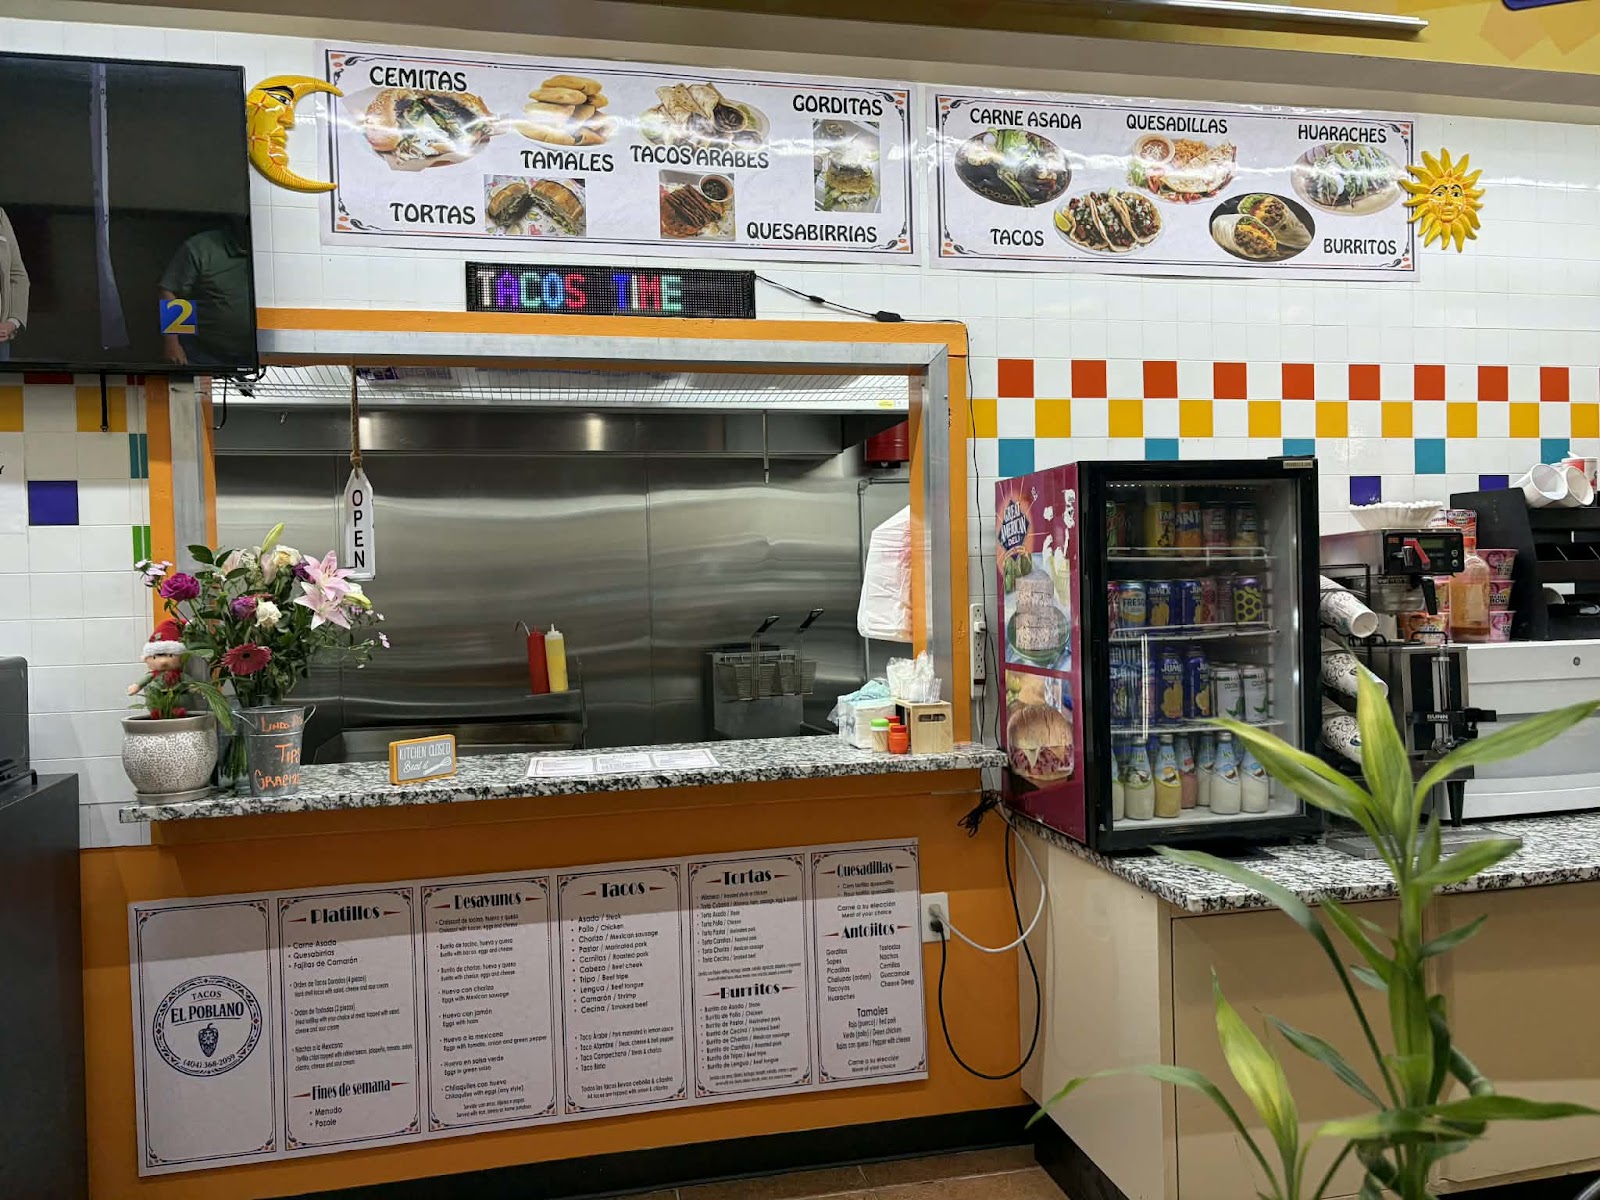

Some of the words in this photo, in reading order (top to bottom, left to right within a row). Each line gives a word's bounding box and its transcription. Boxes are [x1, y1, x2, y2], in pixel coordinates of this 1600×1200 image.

[369, 66, 468, 92] CEMITAS
[792, 93, 883, 117] GORDITAS
[969, 107, 1024, 127] CARNE
[1027, 110, 1082, 130] ASADA
[1126, 113, 1228, 135] QUESADILLAS
[1298, 123, 1387, 144] HUARACHES
[520, 148, 614, 172] TAMALES
[630, 143, 692, 166] TACOS
[697, 147, 769, 170] ARABES
[390, 201, 476, 226] TORTAS
[746, 221, 878, 244] QUESABIRRIAS
[990, 228, 1044, 247] TACOS
[1324, 237, 1397, 256] BURRITOS
[475, 269, 587, 309] TACOS
[162, 298, 195, 334] 2
[352, 489, 365, 568] OPEN
[400, 745, 427, 760] KITCHEN
[428, 742, 451, 757] CLOSED
[837, 861, 894, 878] Quesadillas
[721, 869, 772, 885] Tortas
[600, 881, 645, 898] Tacos
[454, 892, 522, 910] Desayunos
[837, 904, 855, 912] Carne
[310, 905, 381, 924] Platillos
[600, 923, 624, 931] Chicken
[841, 922, 895, 939] Antojitos
[578, 935, 604, 943] Chorizo
[610, 932, 635, 940] Mexican
[635, 930, 659, 938] sausage
[292, 941, 314, 950] Carne
[315, 939, 337, 947] Asada
[579, 945, 599, 953] Pastor
[605, 942, 634, 950] Marinated
[634, 941, 648, 949] pork
[293, 949, 335, 960] Quesabirrias
[579, 954, 607, 963] Carnitas
[636, 951, 649, 959] pork
[826, 948, 848, 956] Gorditas
[293, 961, 315, 971] Fajitas
[326, 956, 358, 966] Camarón
[579, 965, 606, 973] Cabeza
[625, 961, 643, 969] cheek
[826, 958, 842, 966] Sopes
[580, 976, 596, 984] Tripa
[602, 973, 615, 981] Beef
[615, 973, 629, 981] tripe
[827, 975, 851, 984] Chalupas
[880, 970, 910, 978] Guacamole
[191, 990, 222, 1000] TACOS
[442, 987, 460, 995] Huevo
[461, 986, 473, 994] con
[580, 985, 605, 995] Lengua
[624, 981, 645, 990] tongue
[720, 983, 780, 999] Burritos
[580, 994, 612, 1004] Camarón
[617, 992, 637, 1000] Shrimp
[828, 993, 855, 1002] Huaraches
[171, 1007, 187, 1023] EL
[188, 1001, 244, 1020] POBLANO
[474, 1008, 493, 1017] jamón
[580, 1005, 605, 1014] Cecina
[857, 1006, 889, 1018] Tamales
[443, 1036, 462, 1044] Huevo
[312, 1085, 337, 1100] Fines
[339, 1082, 352, 1097] de
[353, 1079, 391, 1096] semana
[489, 1079, 507, 1087] huevo
[581, 1084, 595, 1092] Todos
[314, 1106, 343, 1116] Menudo
[315, 1118, 337, 1127] Pozole
